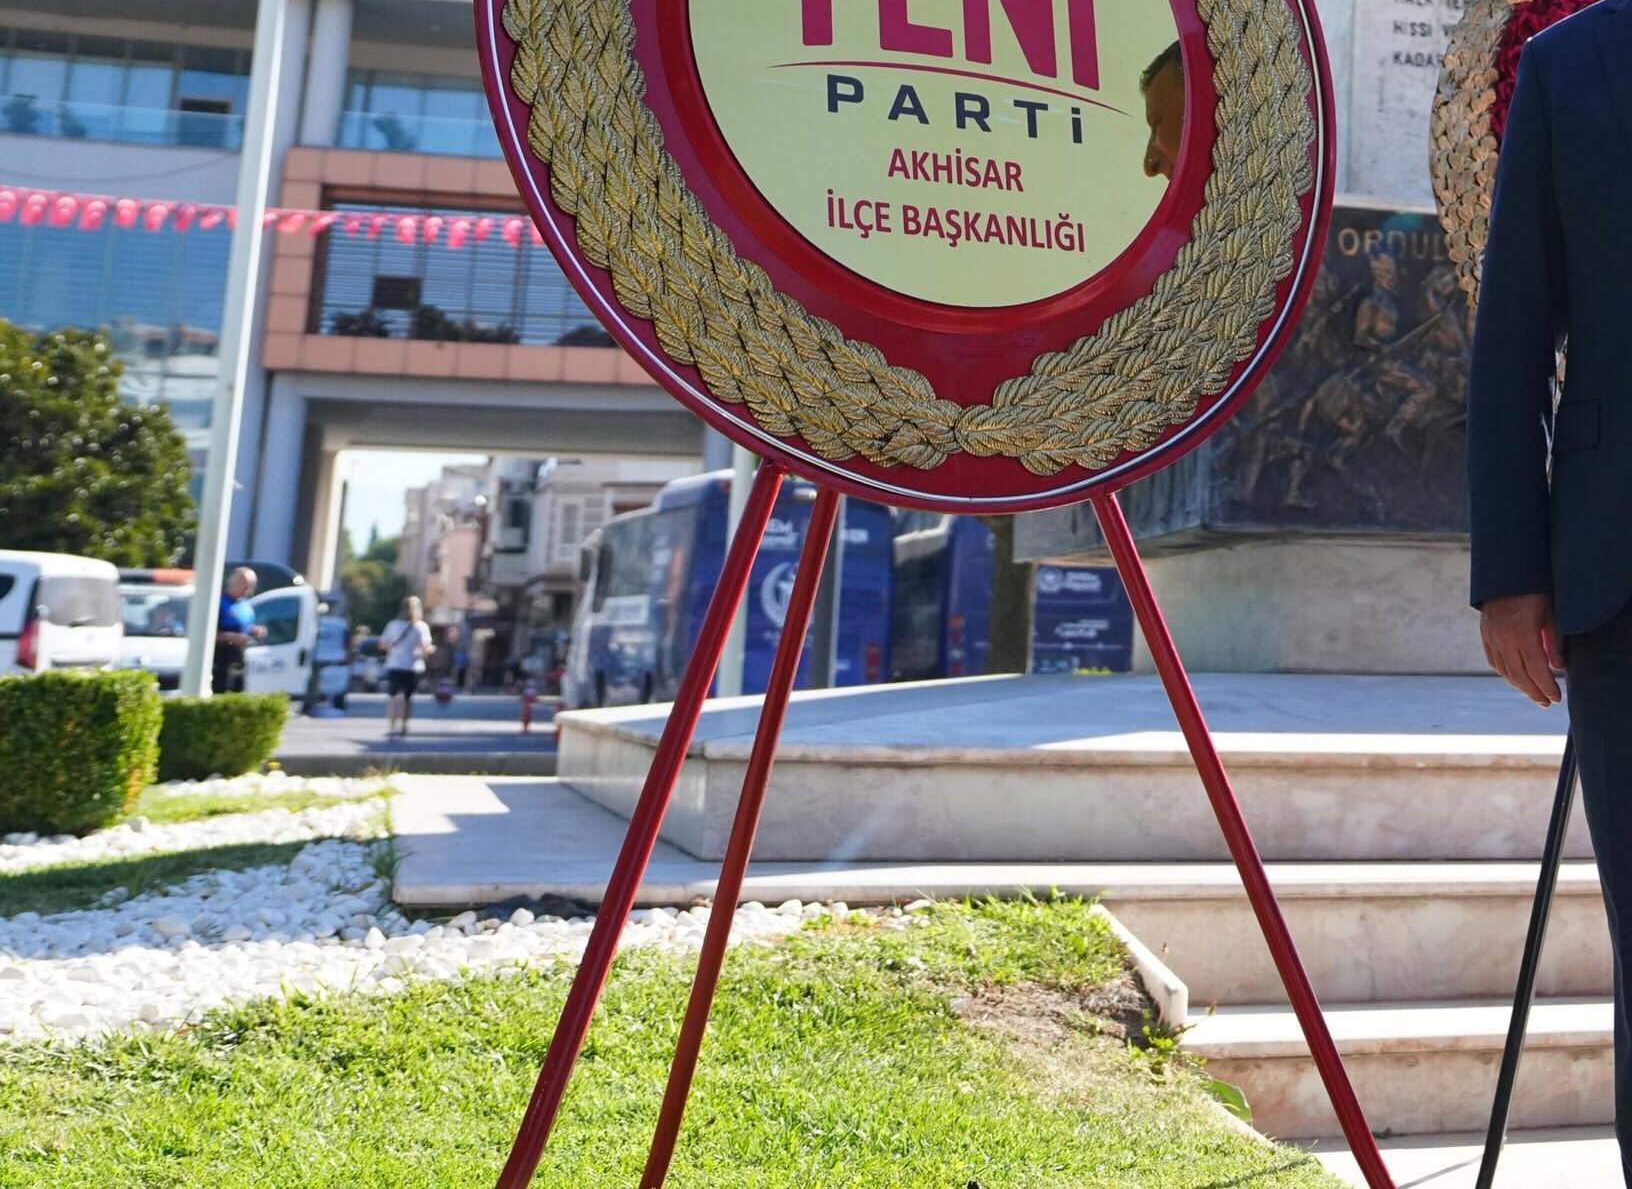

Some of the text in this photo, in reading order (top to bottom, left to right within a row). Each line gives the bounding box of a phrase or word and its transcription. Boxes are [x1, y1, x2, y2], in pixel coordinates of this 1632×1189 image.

[888, 148, 1024, 192] AKHİSAR
[827, 189, 1085, 252] İLÇE BAŞKANLIĞI
